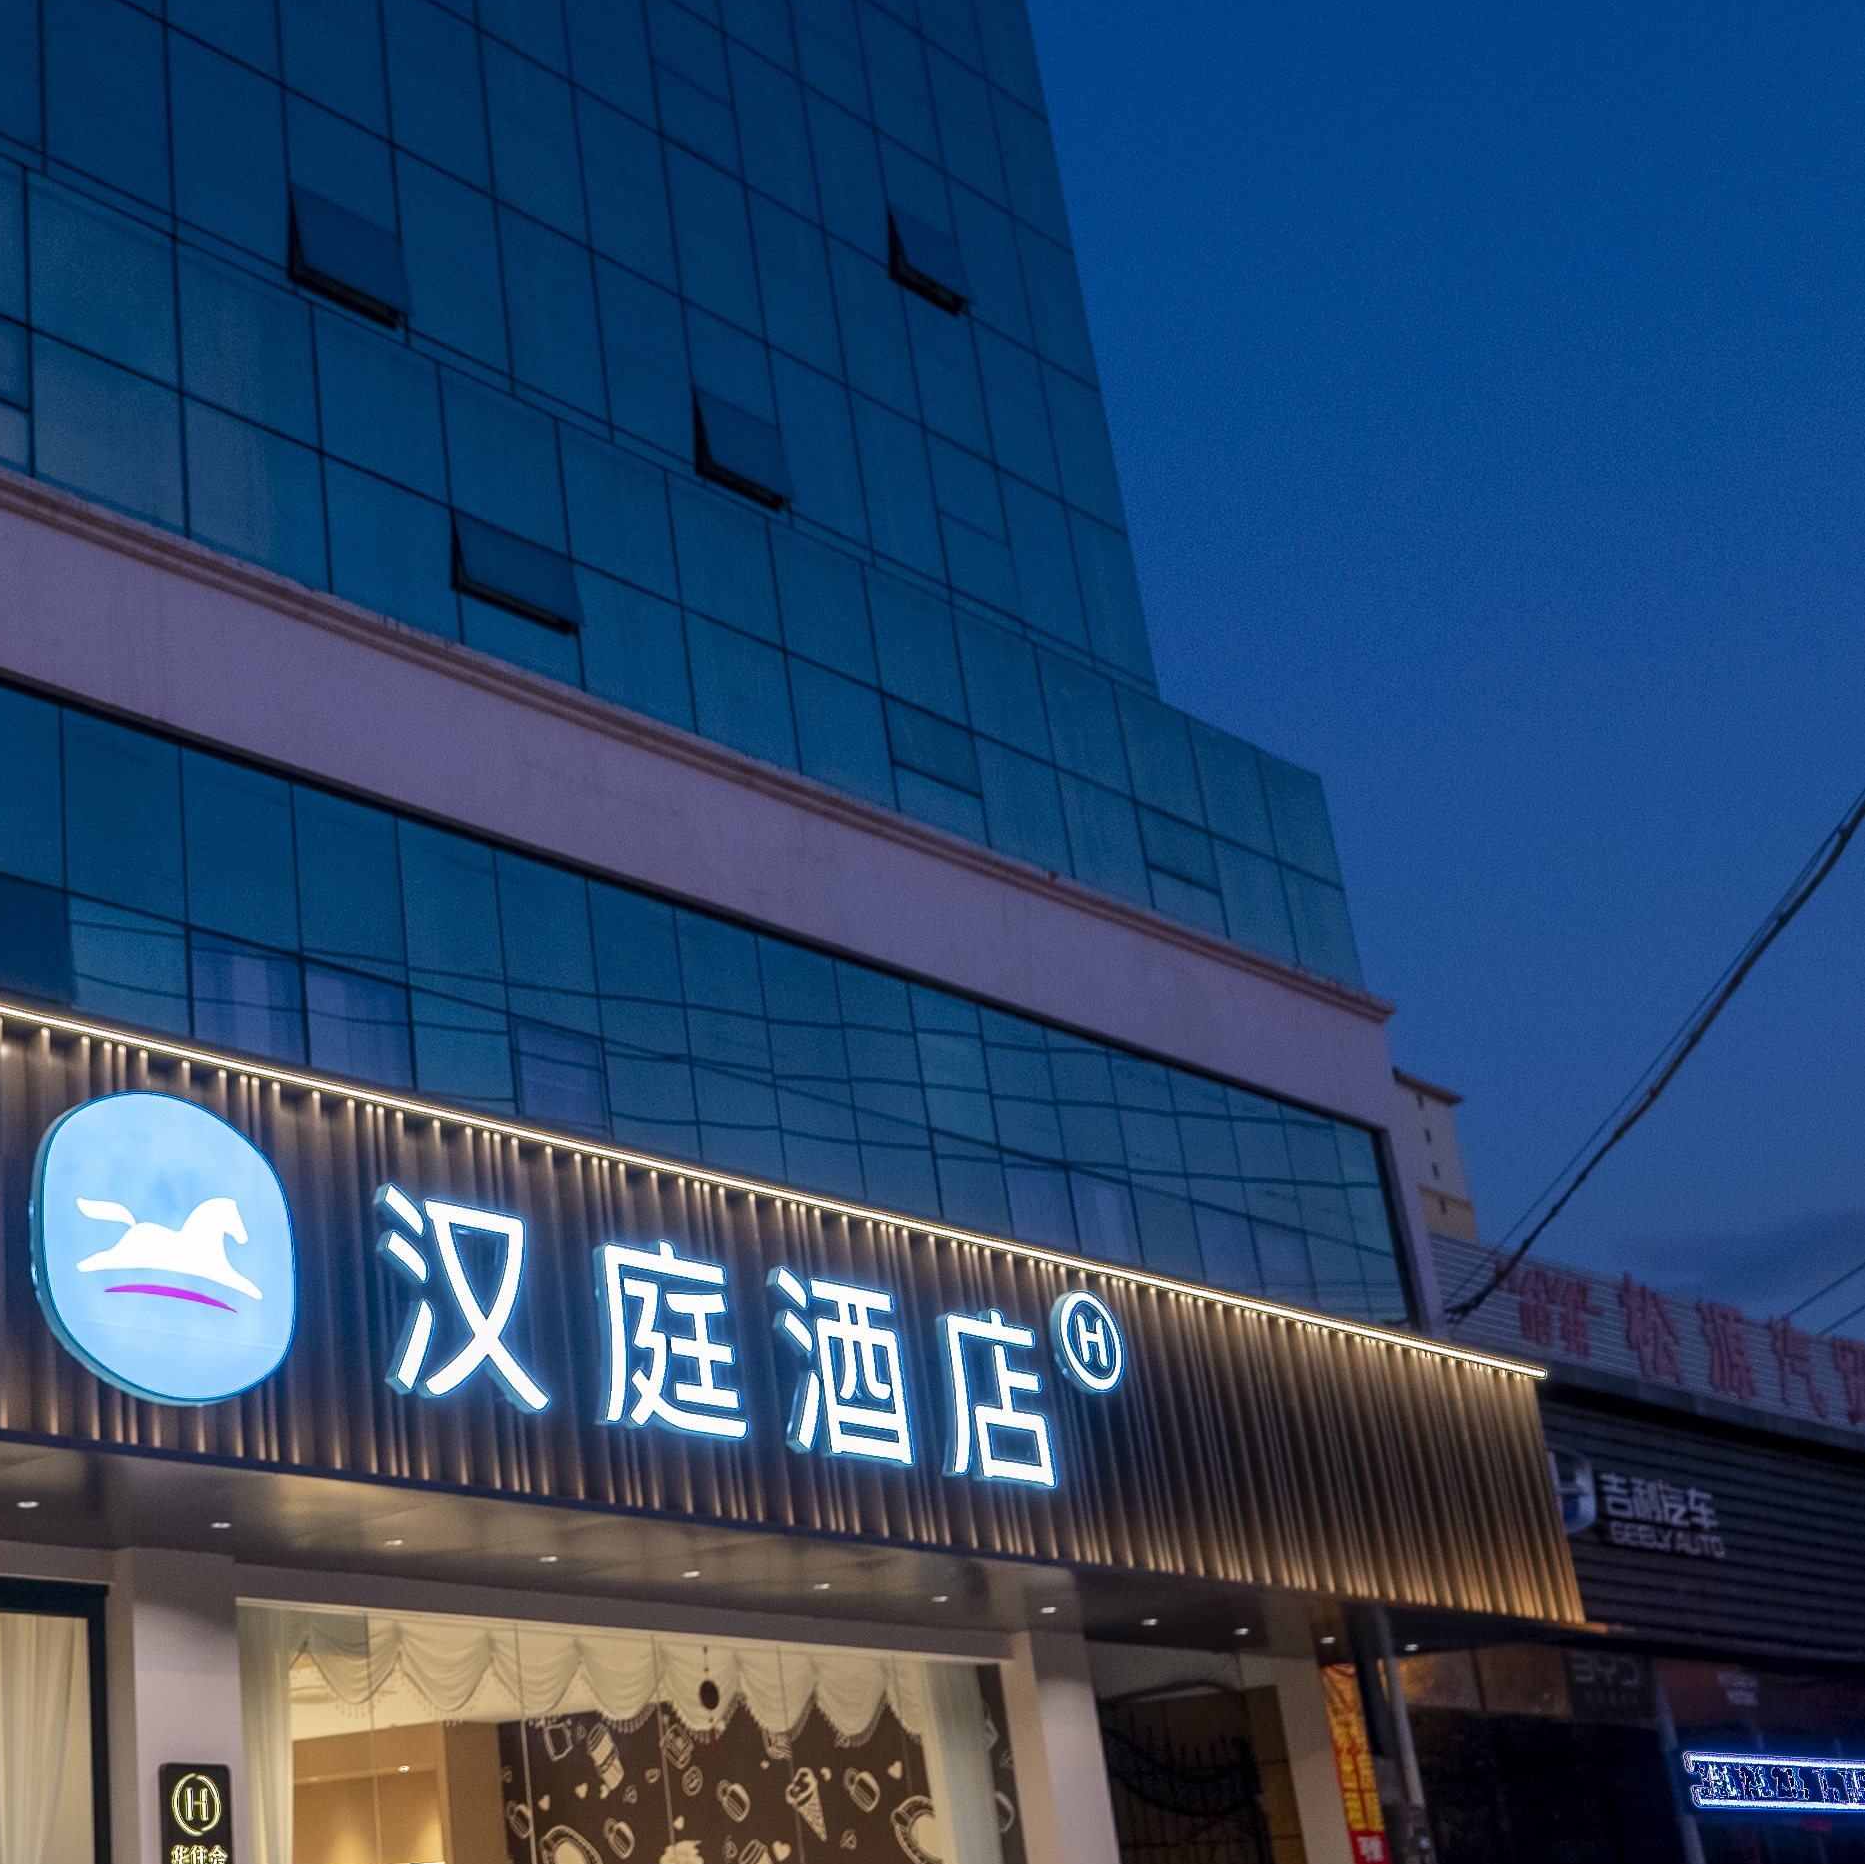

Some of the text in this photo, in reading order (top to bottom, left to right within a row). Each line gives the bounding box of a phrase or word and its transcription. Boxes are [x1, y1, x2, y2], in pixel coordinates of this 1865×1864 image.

[376, 1183, 1058, 1490] 汉庭酒店
[1599, 1472, 1720, 1530] 吉利汽车
